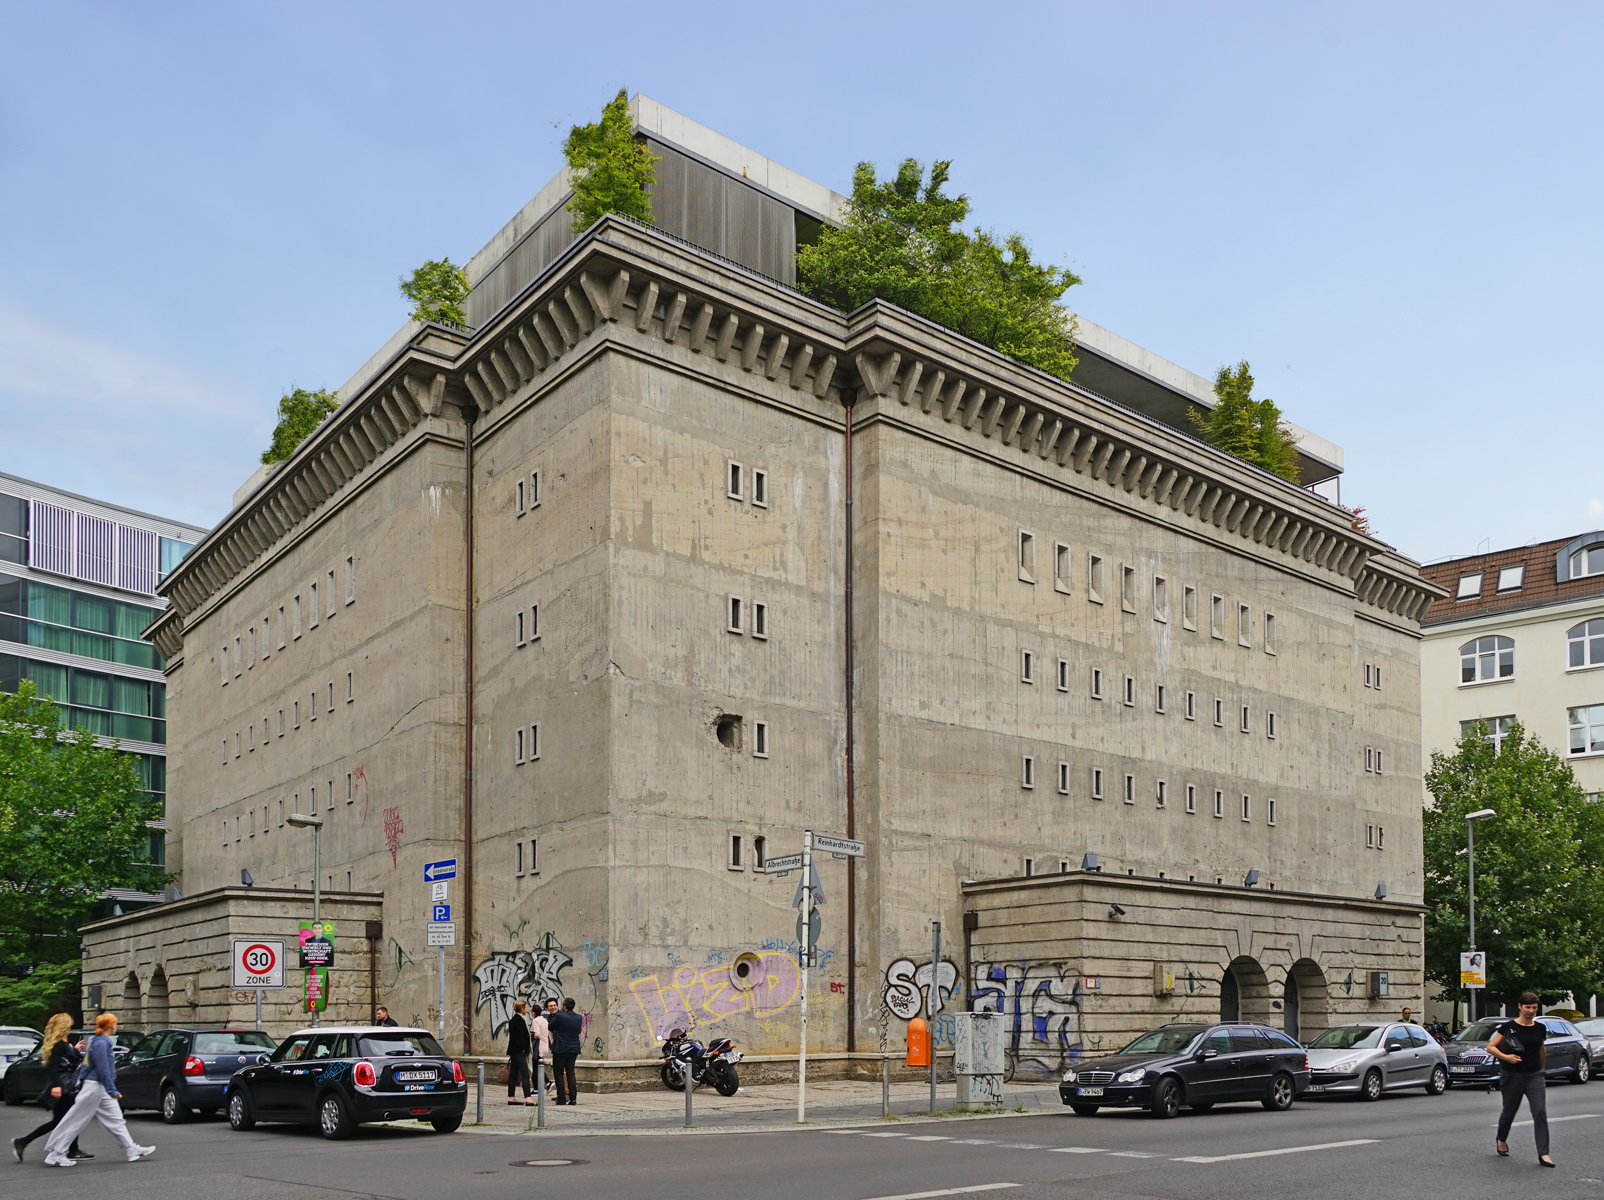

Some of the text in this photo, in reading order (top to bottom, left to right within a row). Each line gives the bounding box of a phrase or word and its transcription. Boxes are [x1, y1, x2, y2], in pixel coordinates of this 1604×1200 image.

[817, 837, 861, 853] Reinhardtstraße
[767, 857, 801, 869] Albrechtstraße
[435, 907, 446, 920] P
[249, 952, 269, 967] 30
[246, 976, 271, 984] ZONE
[1380, 977, 1387, 985] 20
